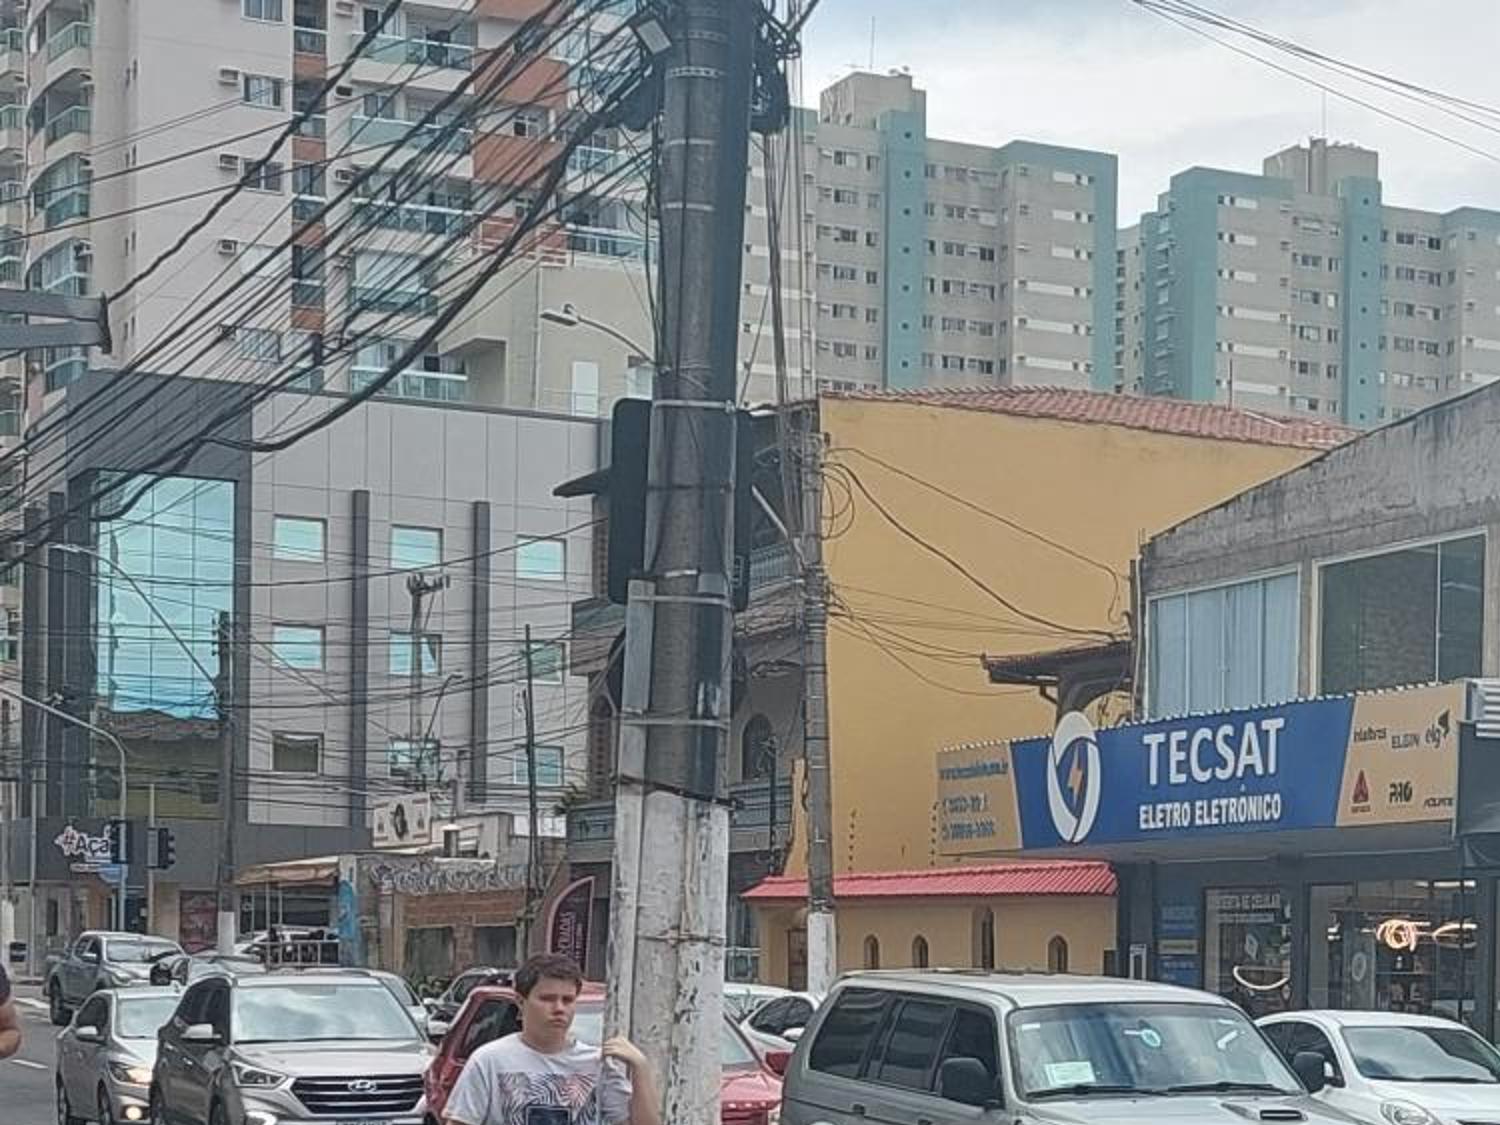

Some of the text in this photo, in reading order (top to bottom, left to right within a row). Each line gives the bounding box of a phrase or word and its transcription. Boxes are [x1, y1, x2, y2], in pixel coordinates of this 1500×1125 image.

[1142, 717, 1286, 786] TECSAT
[1139, 783, 1281, 830] ELETRO ELETRÔNICO
